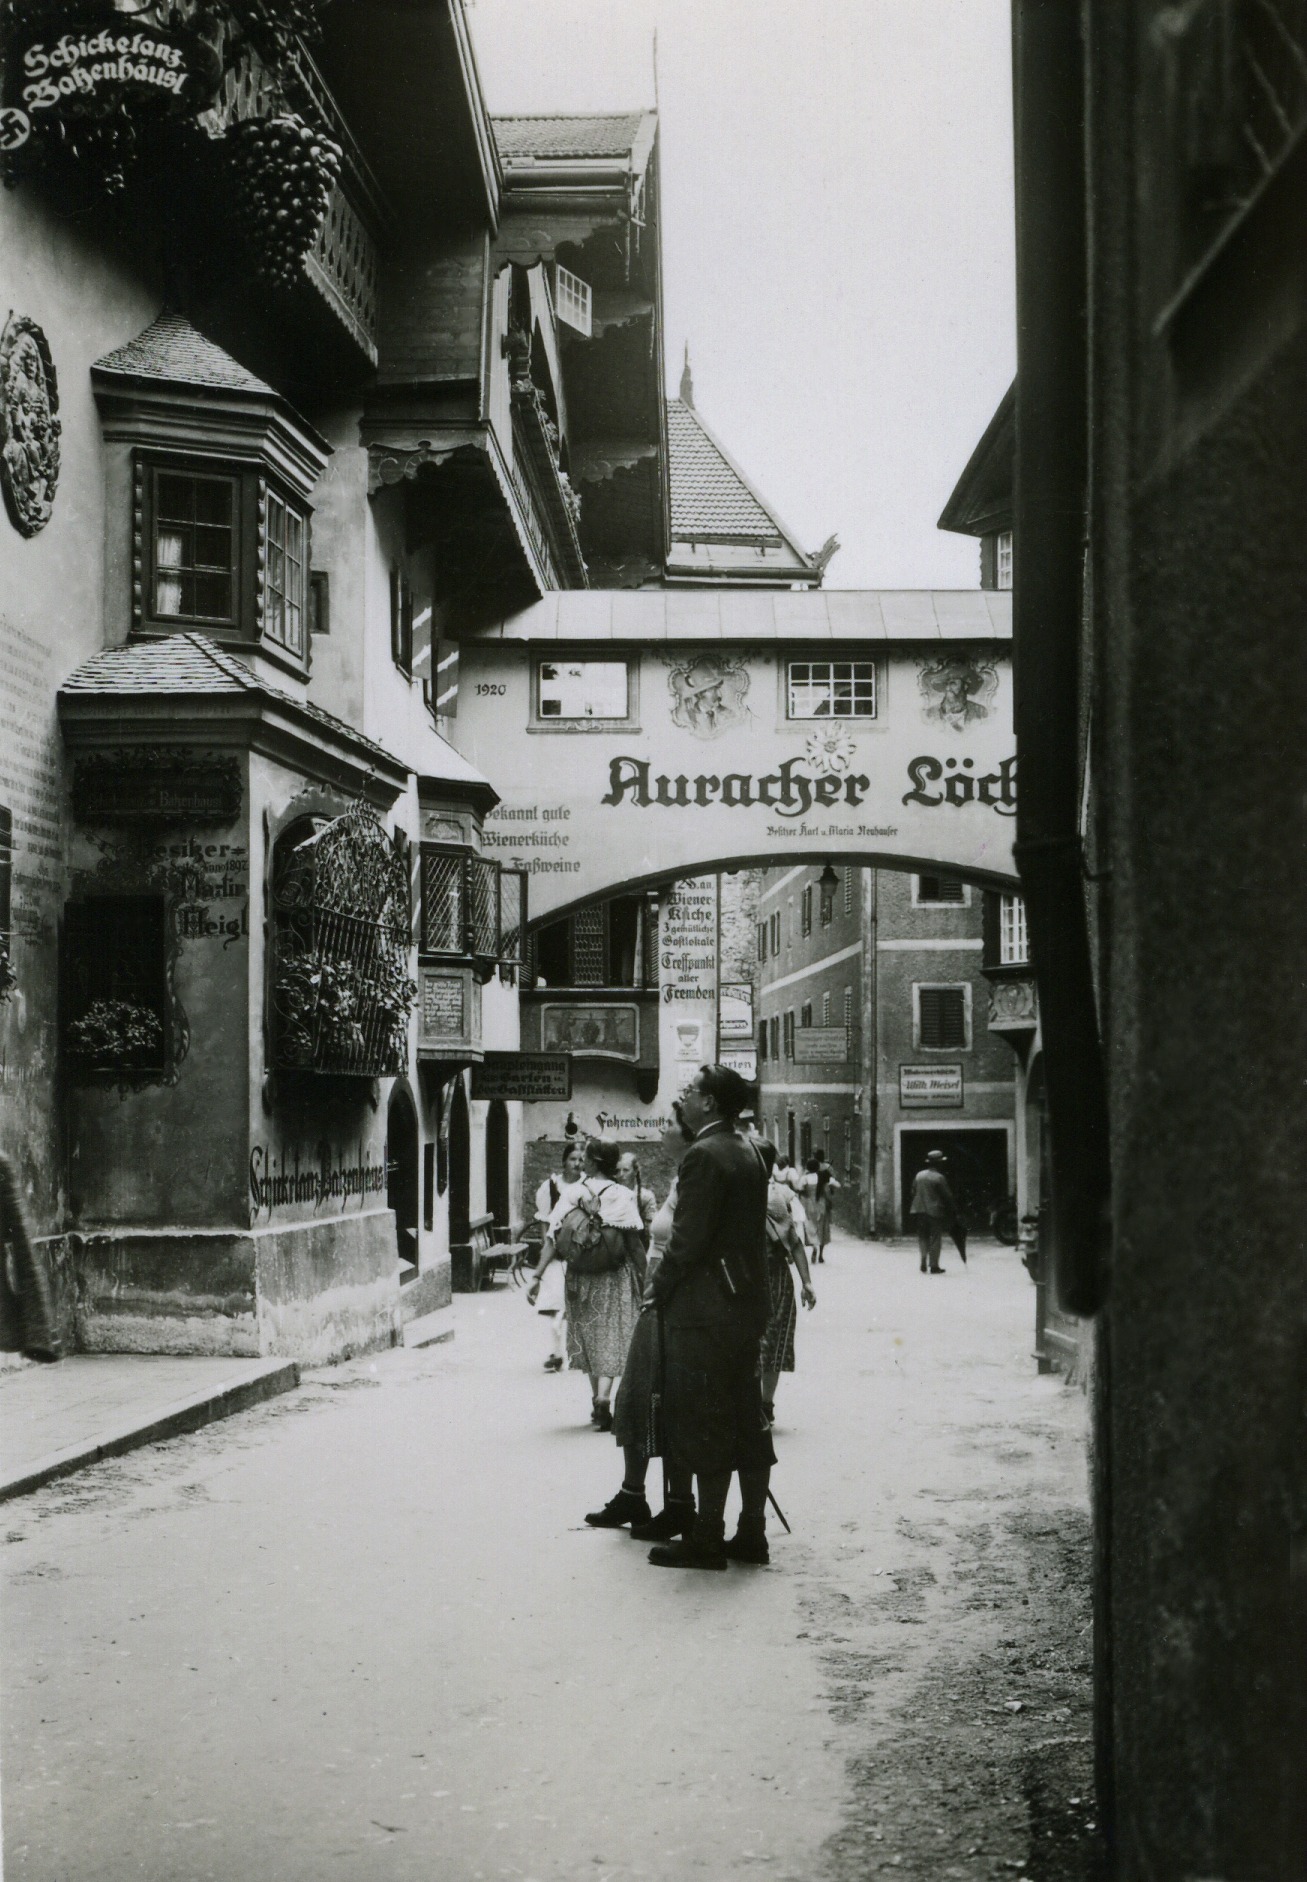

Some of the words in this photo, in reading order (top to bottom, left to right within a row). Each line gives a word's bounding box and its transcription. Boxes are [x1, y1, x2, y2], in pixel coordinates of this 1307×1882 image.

[22, 54, 189, 113] Batzenhäusl
[472, 683, 507, 698] 1920
[600, 756, 871, 818] Auracher
[542, 804, 571, 824] gute
[482, 829, 570, 849] Wienerküche
[829, 824, 854, 838] Maria
[661, 951, 716, 974] Treffpunkt
[677, 974, 700, 983] aller
[661, 983, 716, 1004] Fremden
